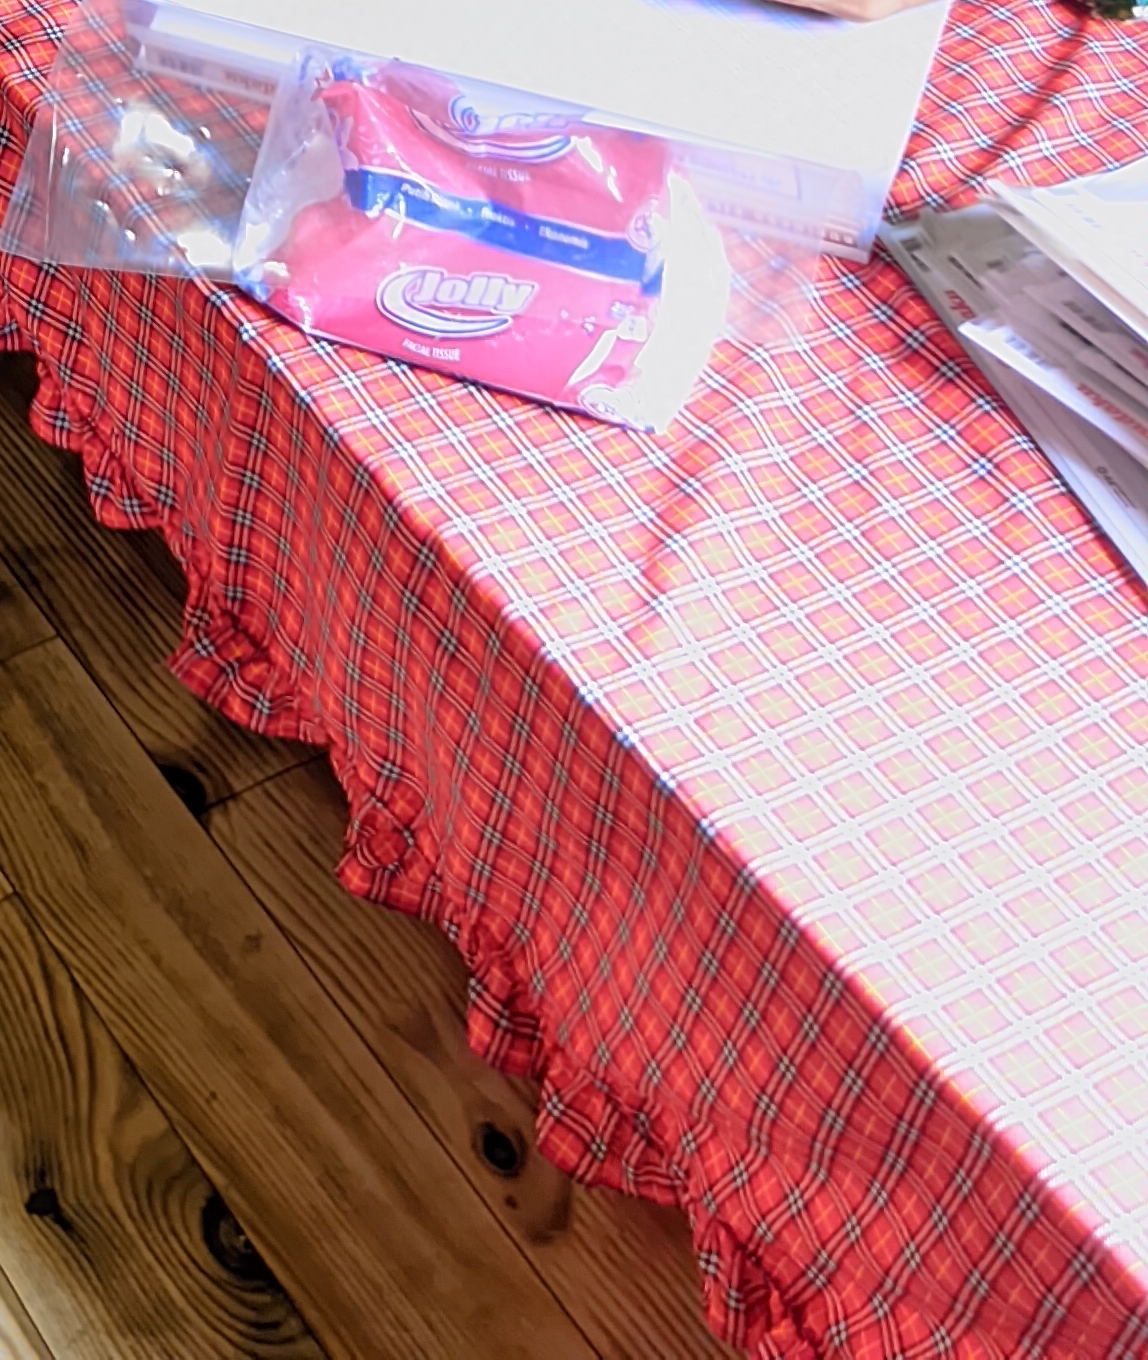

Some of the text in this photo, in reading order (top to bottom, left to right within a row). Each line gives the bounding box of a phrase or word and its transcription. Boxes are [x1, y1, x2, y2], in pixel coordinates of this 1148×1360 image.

[412, 270, 536, 313] Jolly
[402, 338, 461, 361] FACIAL TISSUE
